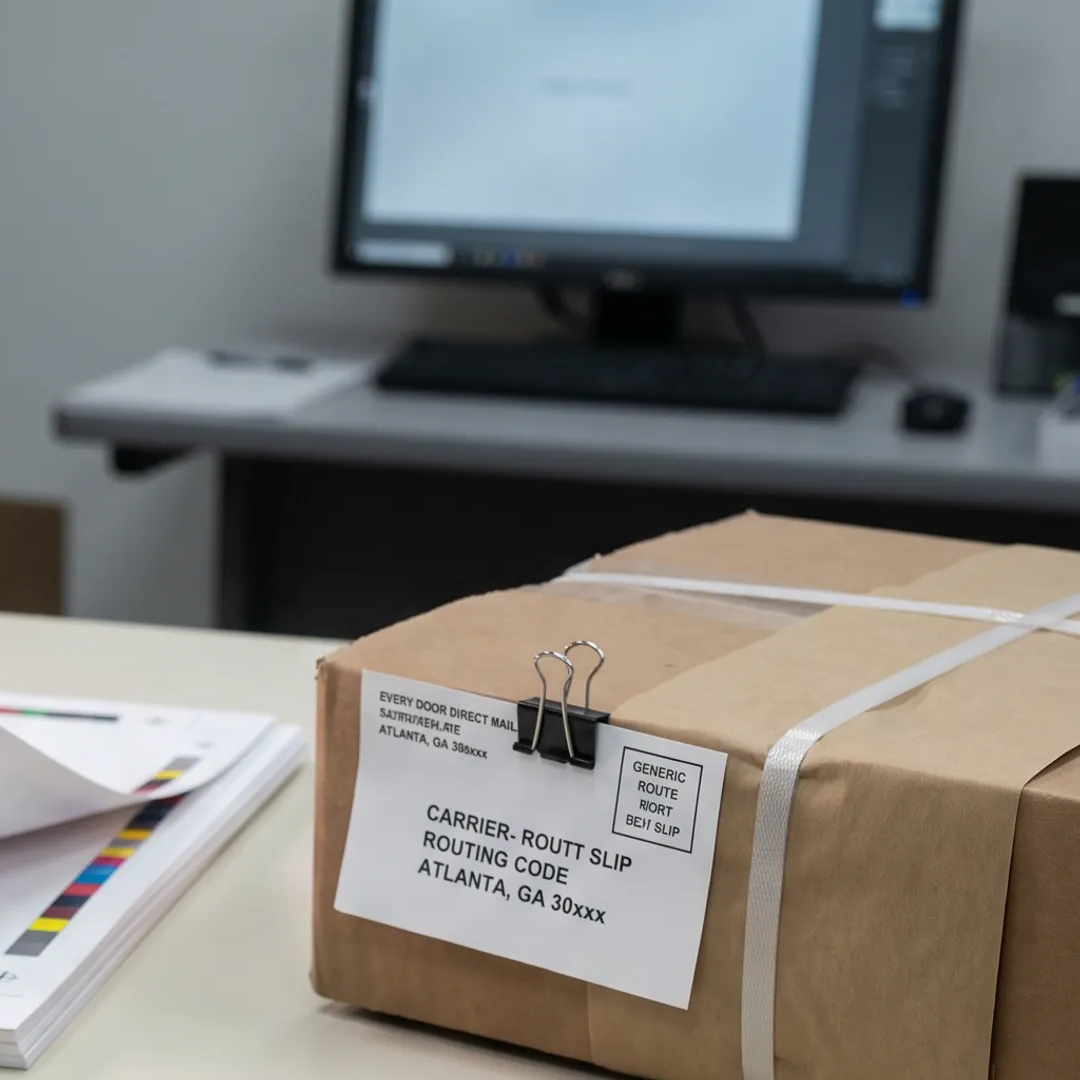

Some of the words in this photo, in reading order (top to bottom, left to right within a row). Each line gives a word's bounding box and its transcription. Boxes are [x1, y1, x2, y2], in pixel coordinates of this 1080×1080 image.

[380, 691, 414, 708] EVERY
[416, 699, 447, 716] DOOR
[450, 707, 488, 725] DIRECT
[379, 724, 429, 747] ATLANTA,
[433, 737, 448, 749] GA
[633, 761, 686, 783] GENERIC
[638, 780, 679, 800] ROUTE
[427, 804, 516, 841] CARRIER-
[521, 829, 585, 860] ROUTT
[589, 848, 632, 872] SLIP
[654, 822, 680, 837] SLIP
[423, 830, 508, 868] ROUTING
[514, 856, 569, 885] CODE
[418, 858, 510, 900] ATLANTA,
[518, 885, 545, 908] GA
[551, 894, 606, 924] 30xxx
